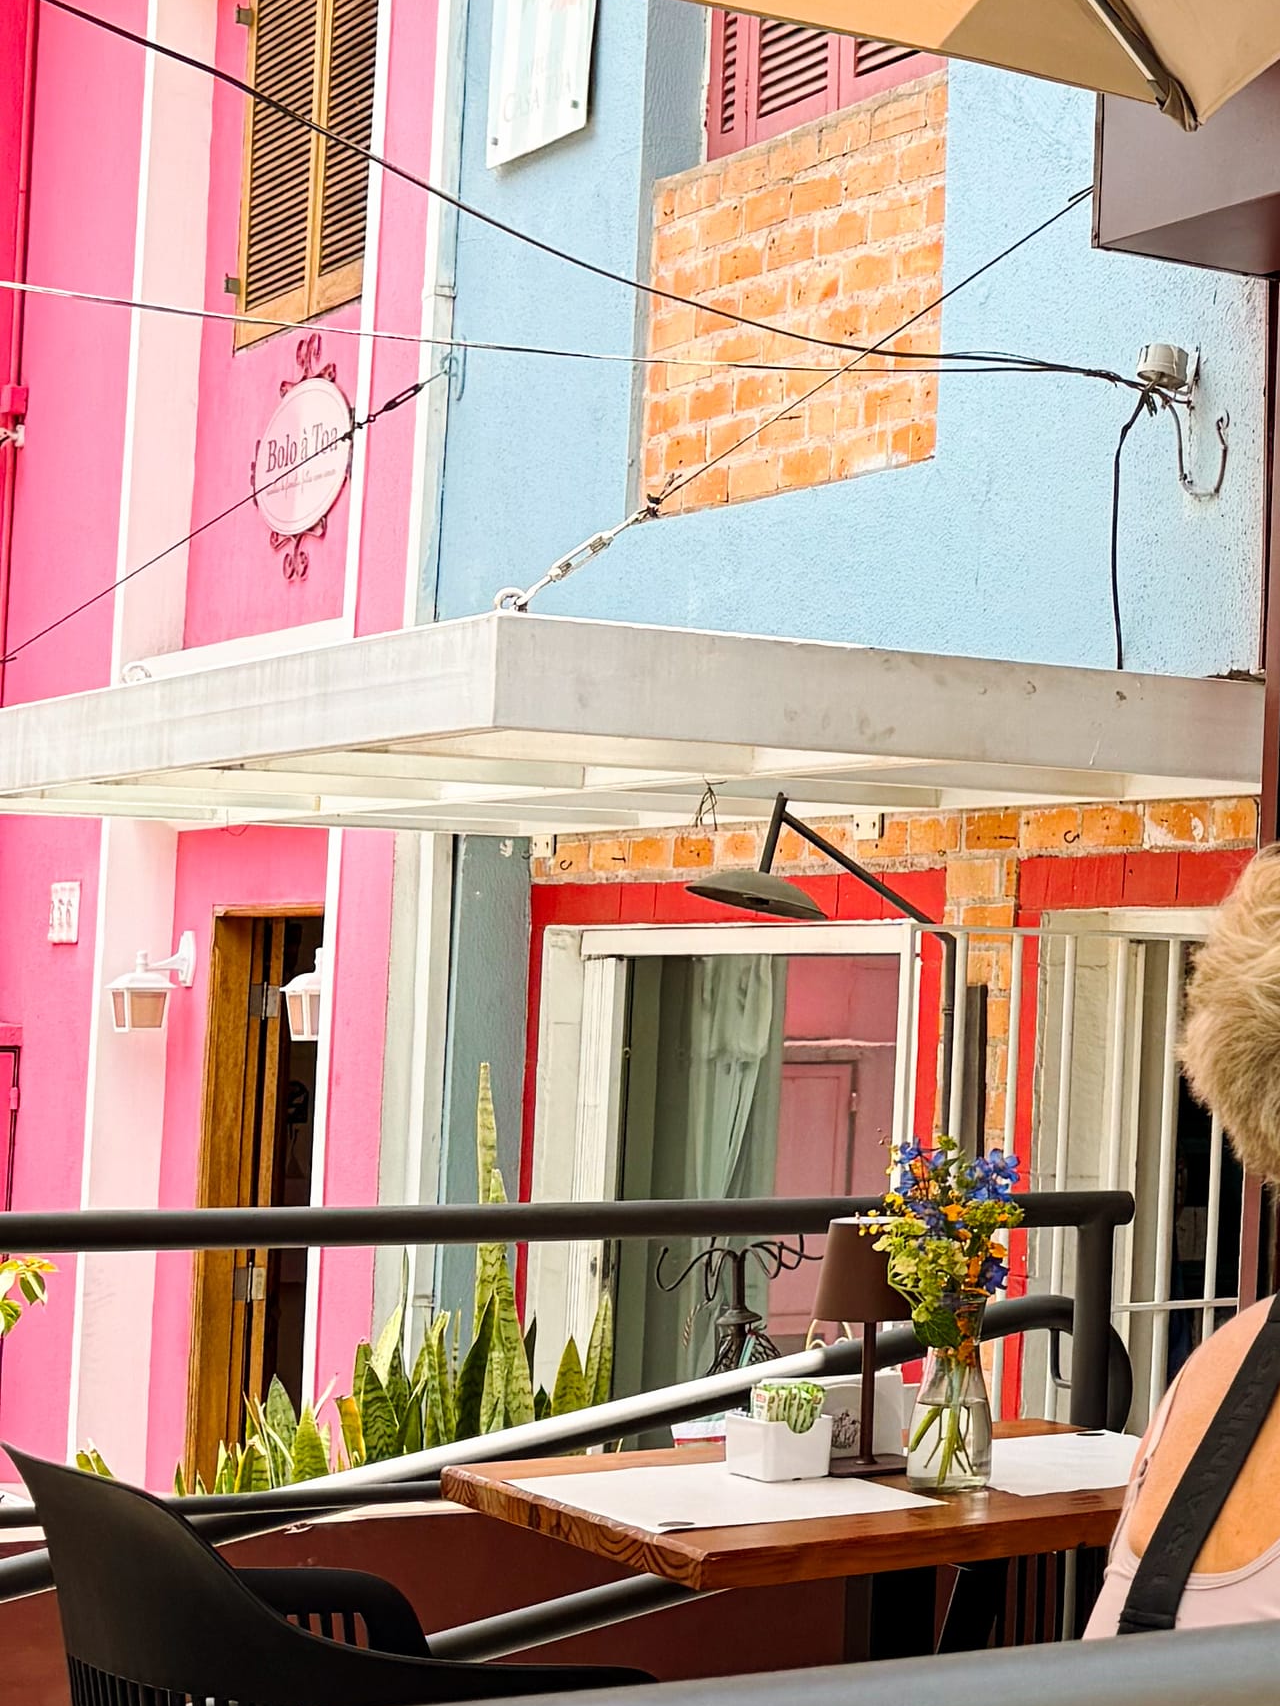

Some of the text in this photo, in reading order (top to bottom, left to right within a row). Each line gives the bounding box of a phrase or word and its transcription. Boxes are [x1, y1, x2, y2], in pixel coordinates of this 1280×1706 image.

[267, 422, 338, 473] Bolo à Toa
